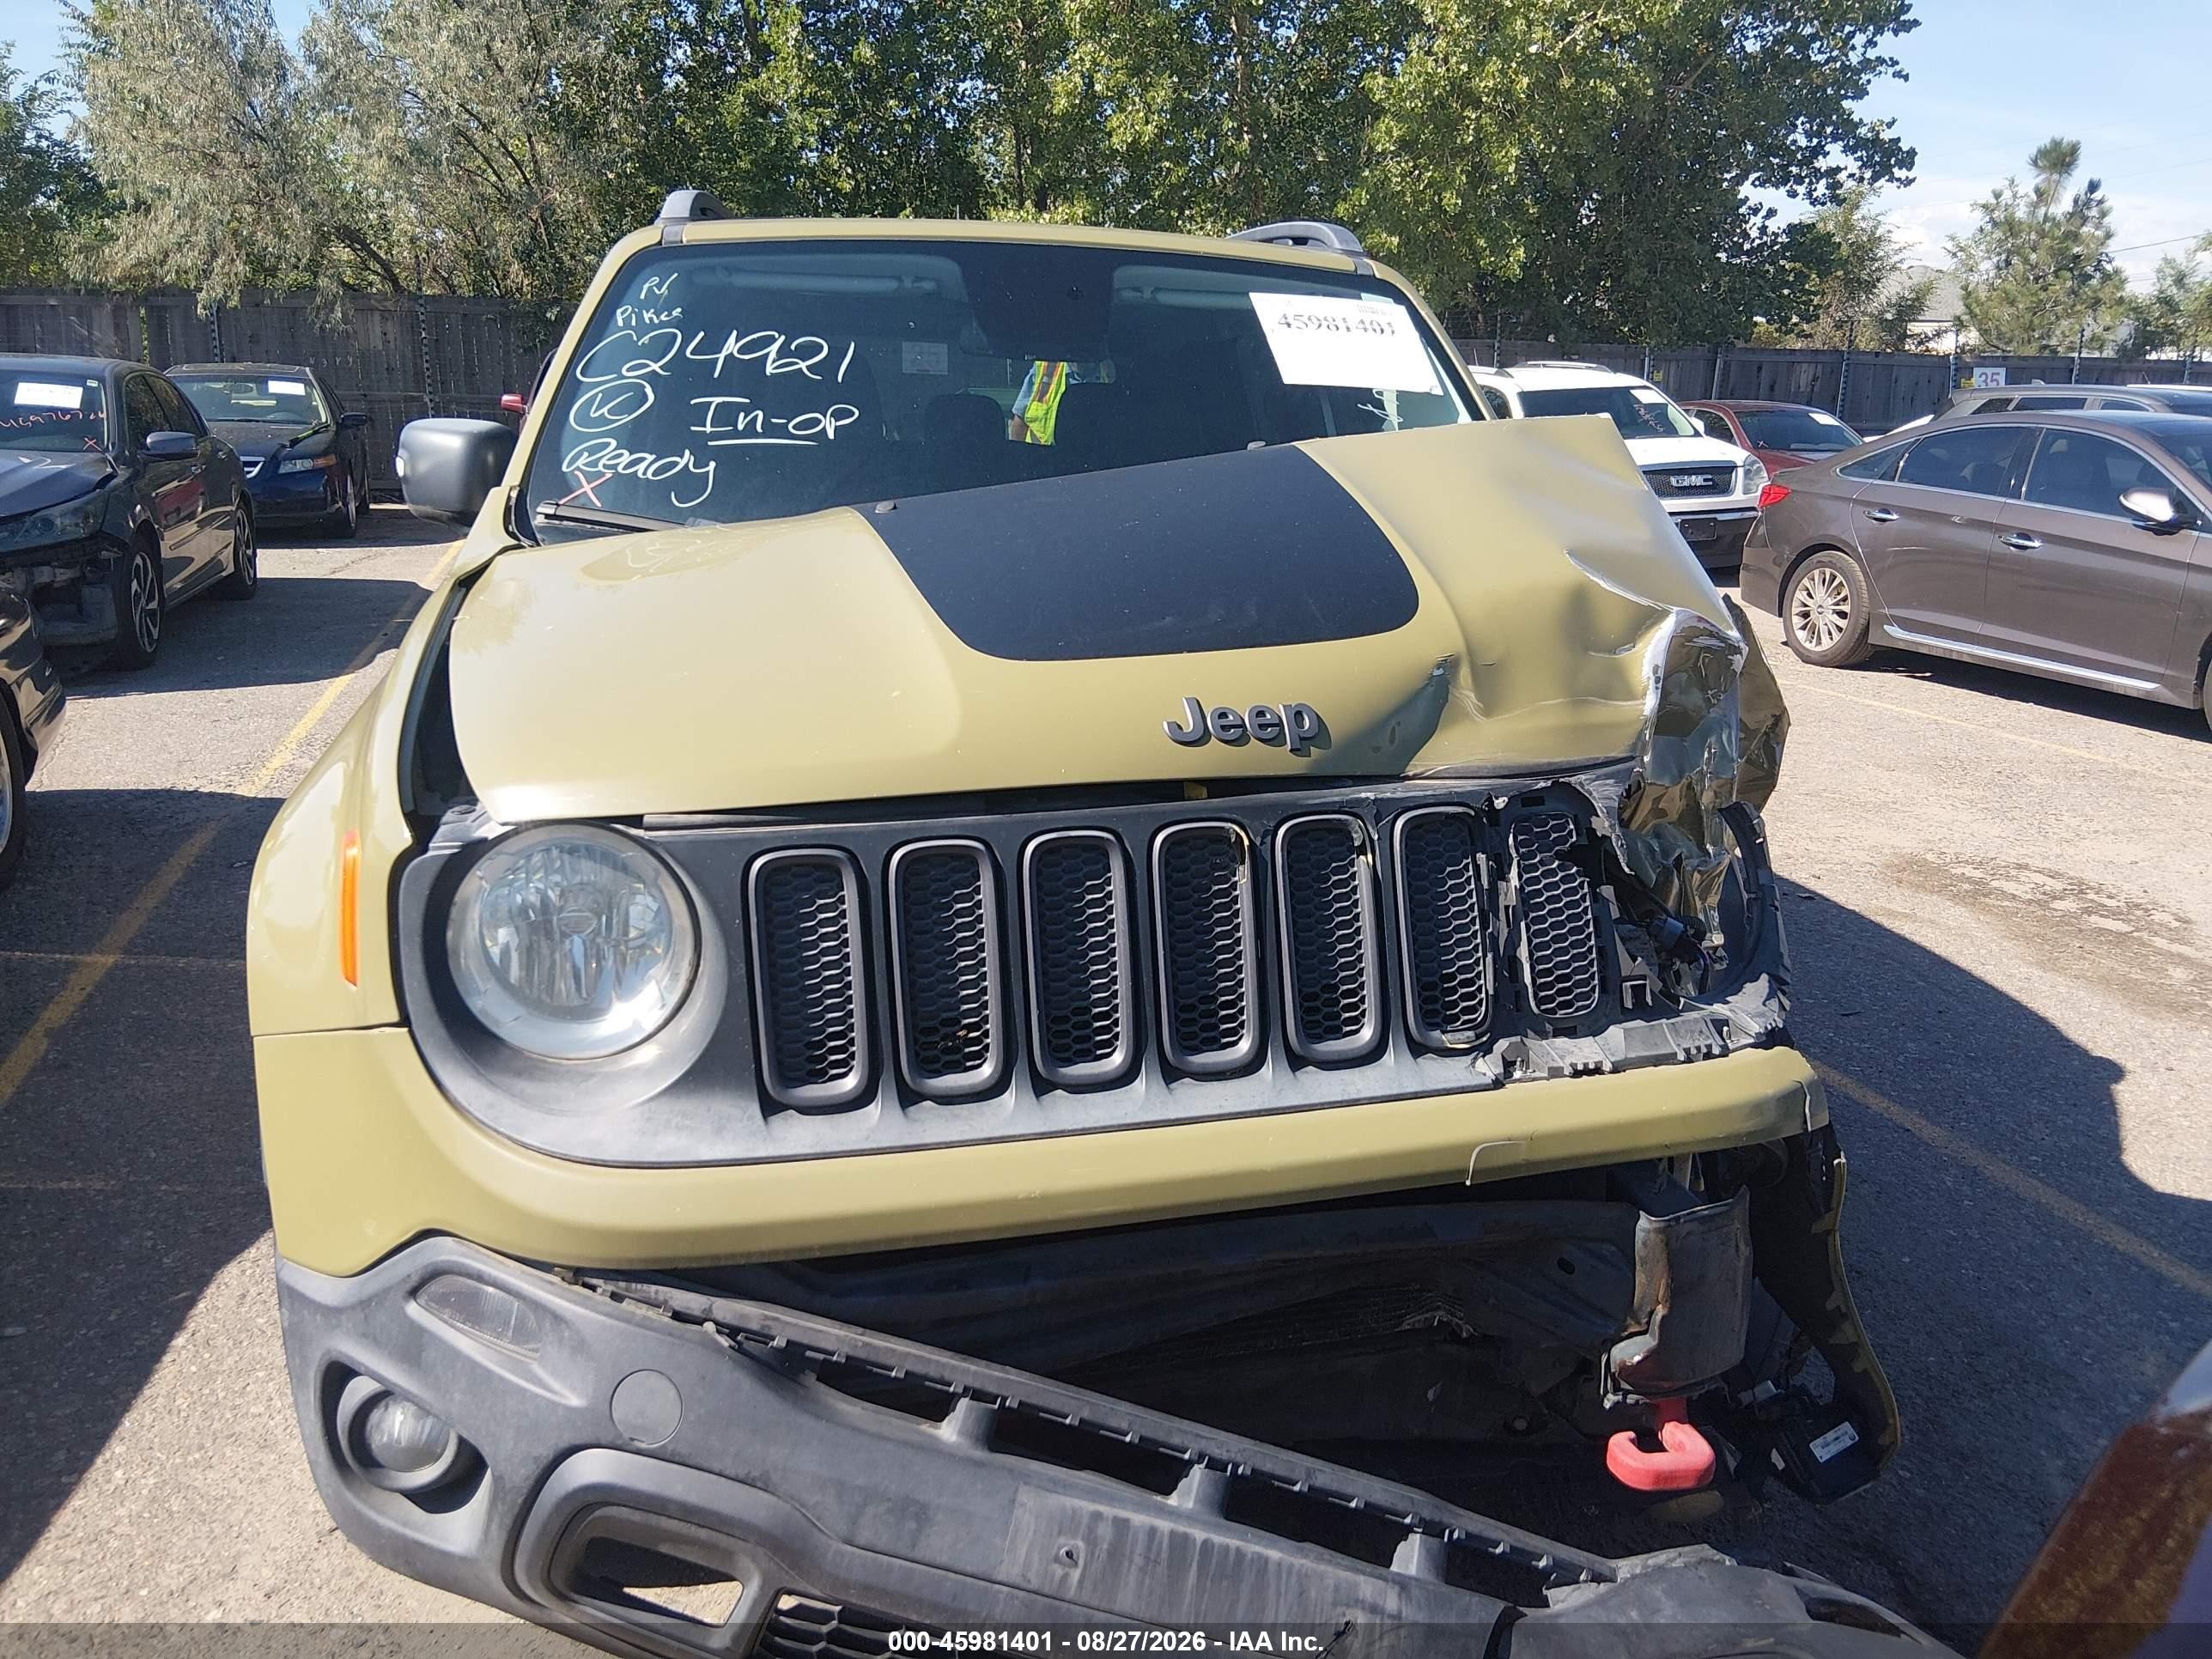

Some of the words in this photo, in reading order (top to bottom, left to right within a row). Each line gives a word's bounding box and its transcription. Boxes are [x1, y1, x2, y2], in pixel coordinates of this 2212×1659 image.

[1277, 313, 1396, 337] 45981401
[1978, 371, 2001, 387] 35
[561, 437, 718, 508] Ready
[1670, 473, 1713, 488] GMC
[1162, 696, 1321, 753] Jeep
